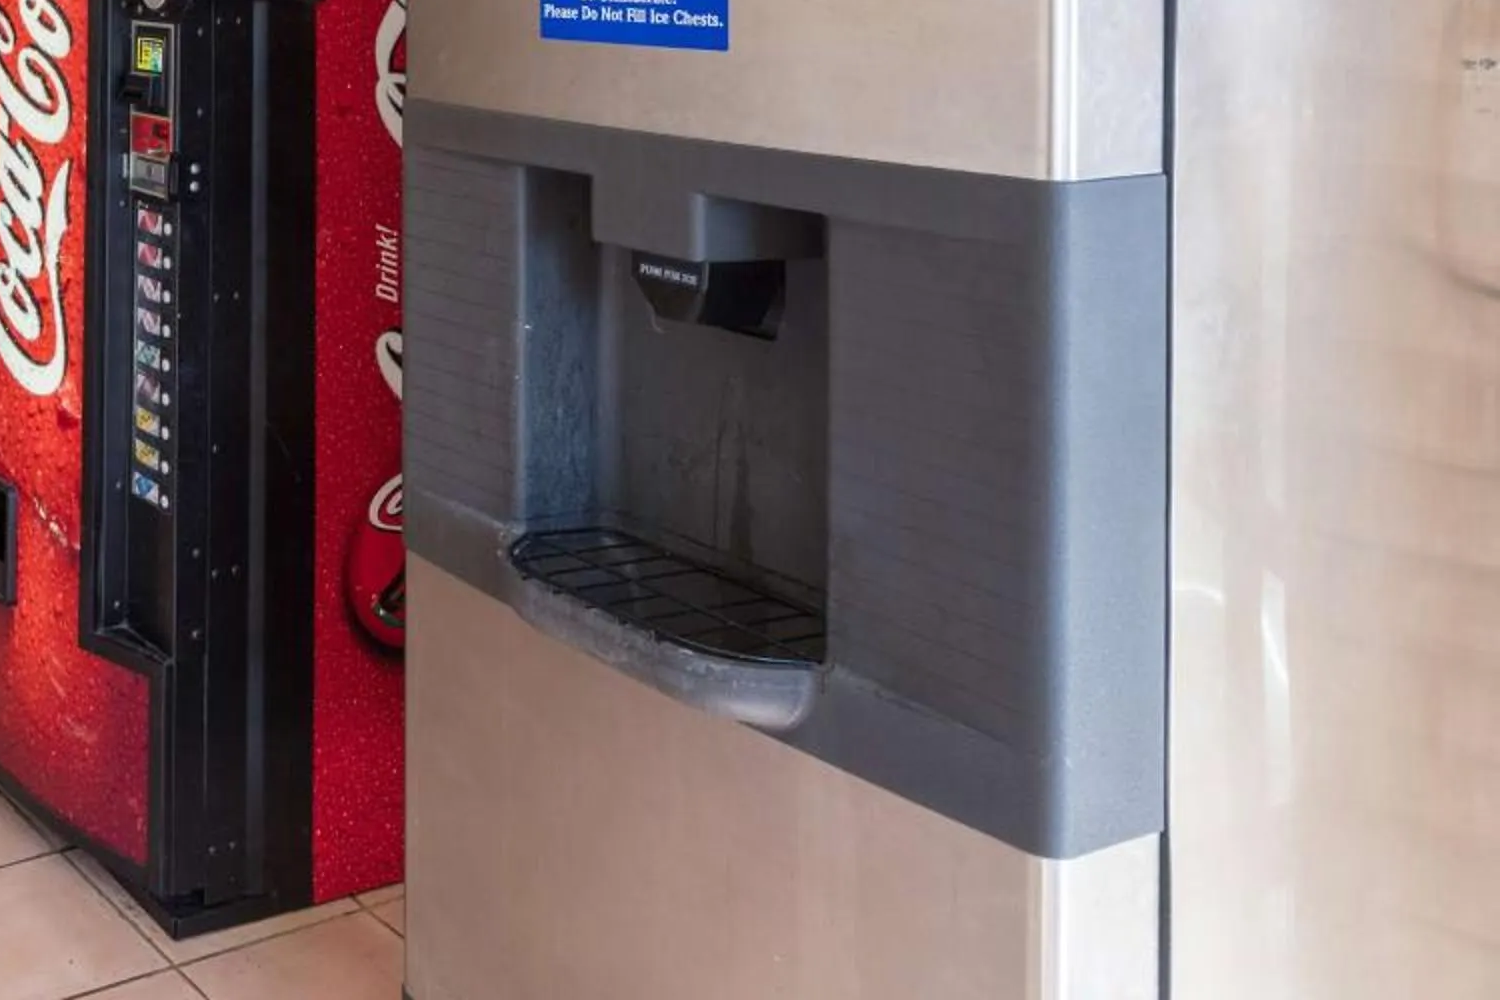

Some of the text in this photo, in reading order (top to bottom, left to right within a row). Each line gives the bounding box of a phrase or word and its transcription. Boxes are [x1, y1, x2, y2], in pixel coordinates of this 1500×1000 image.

[543, 4, 724, 28] Please Do Not Fill Ice Chests.
[375, 222, 399, 303] Drink!
